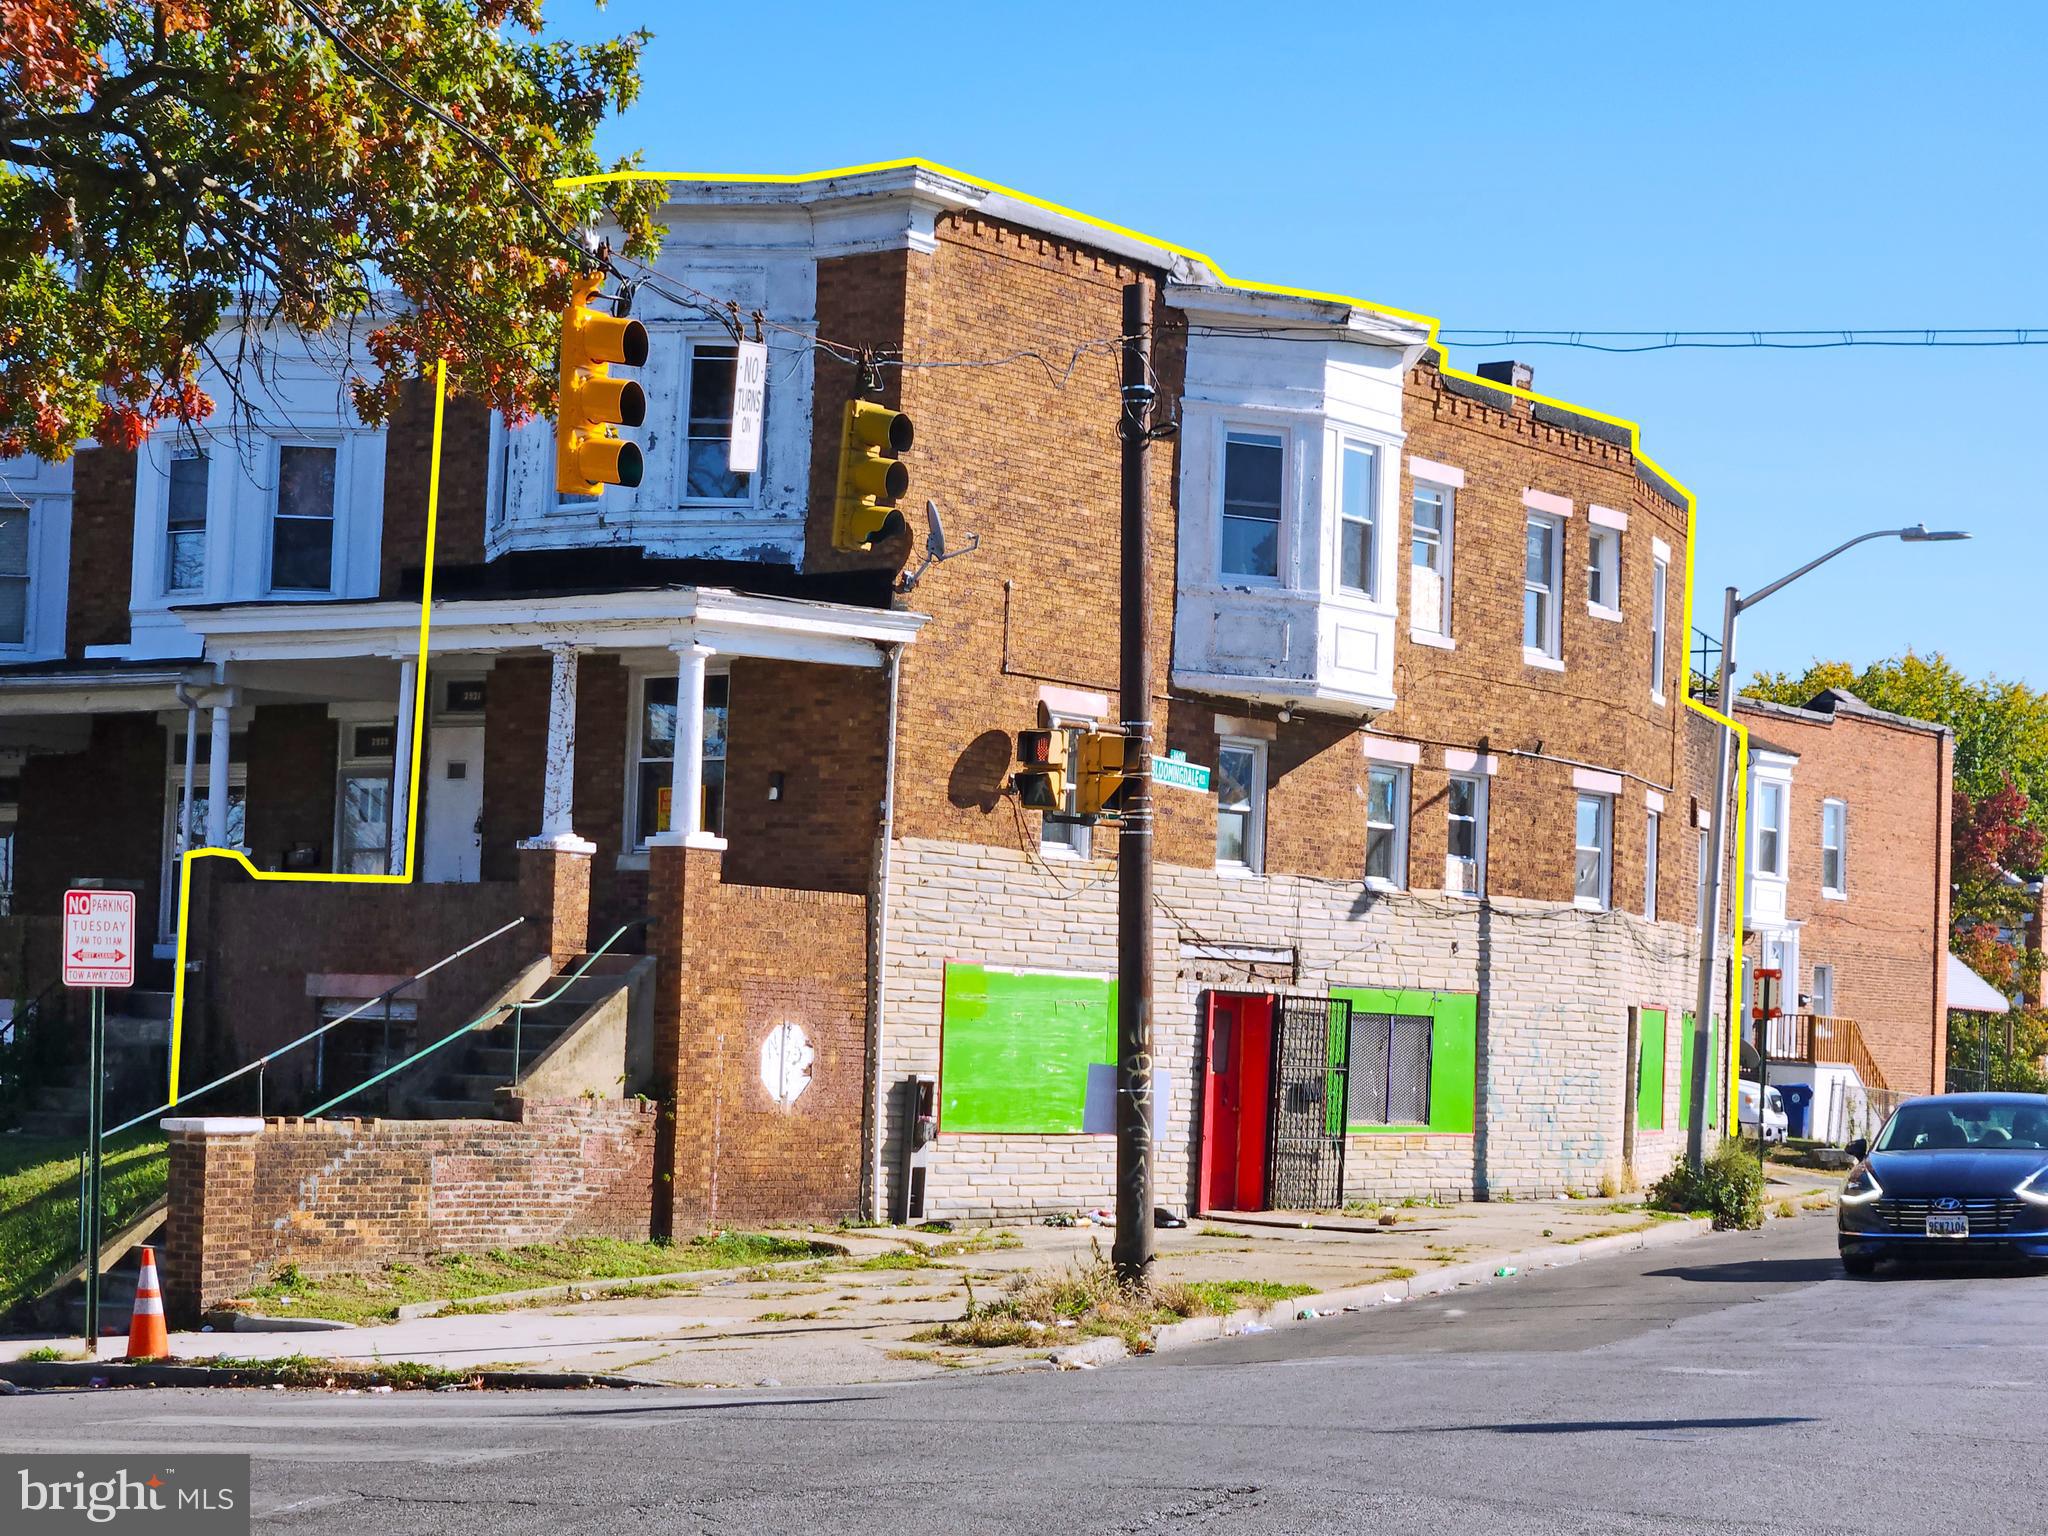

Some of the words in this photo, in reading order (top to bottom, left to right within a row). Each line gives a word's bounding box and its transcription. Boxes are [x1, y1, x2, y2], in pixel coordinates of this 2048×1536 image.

[743, 356, 759, 384] NO
[738, 388, 761, 413] TURNS
[741, 416, 751, 433] ON
[1152, 760, 1200, 787] BLOOMINGDALE
[69, 896, 90, 914] NO
[92, 899, 129, 913] PARKING
[73, 920, 126, 932] TUESDAY
[76, 935, 90, 945] 7AM
[93, 935, 102, 945] TO
[105, 936, 122, 946] 11AM
[69, 970, 84, 980] TOW
[87, 971, 108, 980] AWAY
[110, 971, 129, 981] ZONE
